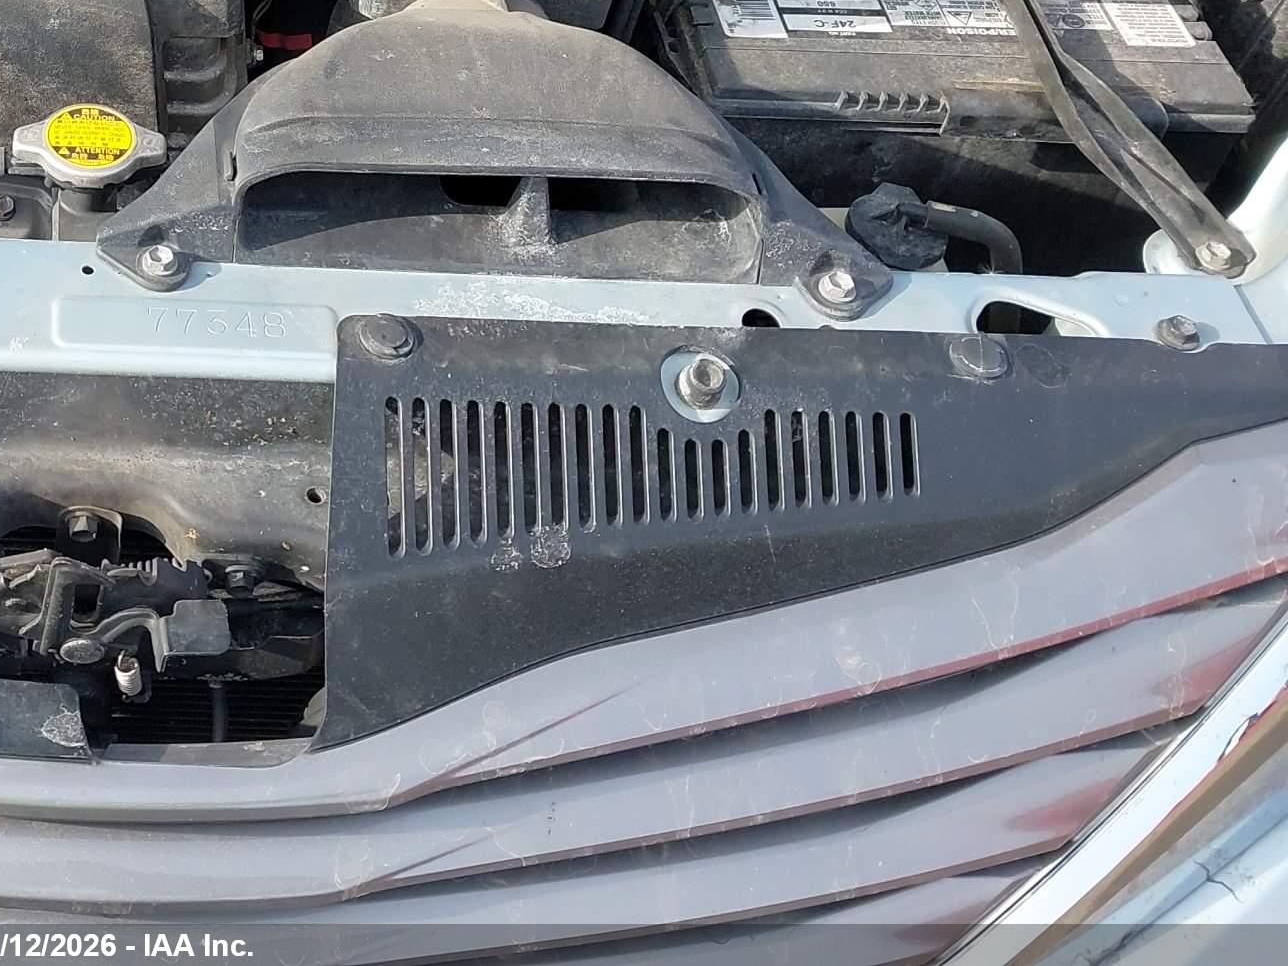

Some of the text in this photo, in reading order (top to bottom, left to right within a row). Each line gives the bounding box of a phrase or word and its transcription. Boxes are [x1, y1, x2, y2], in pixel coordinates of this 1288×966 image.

[813, 19, 857, 29] 24F-C
[946, 27, 1017, 37] ER/POISON
[75, 146, 121, 155] ATTENTION
[147, 306, 287, 339] 77348
